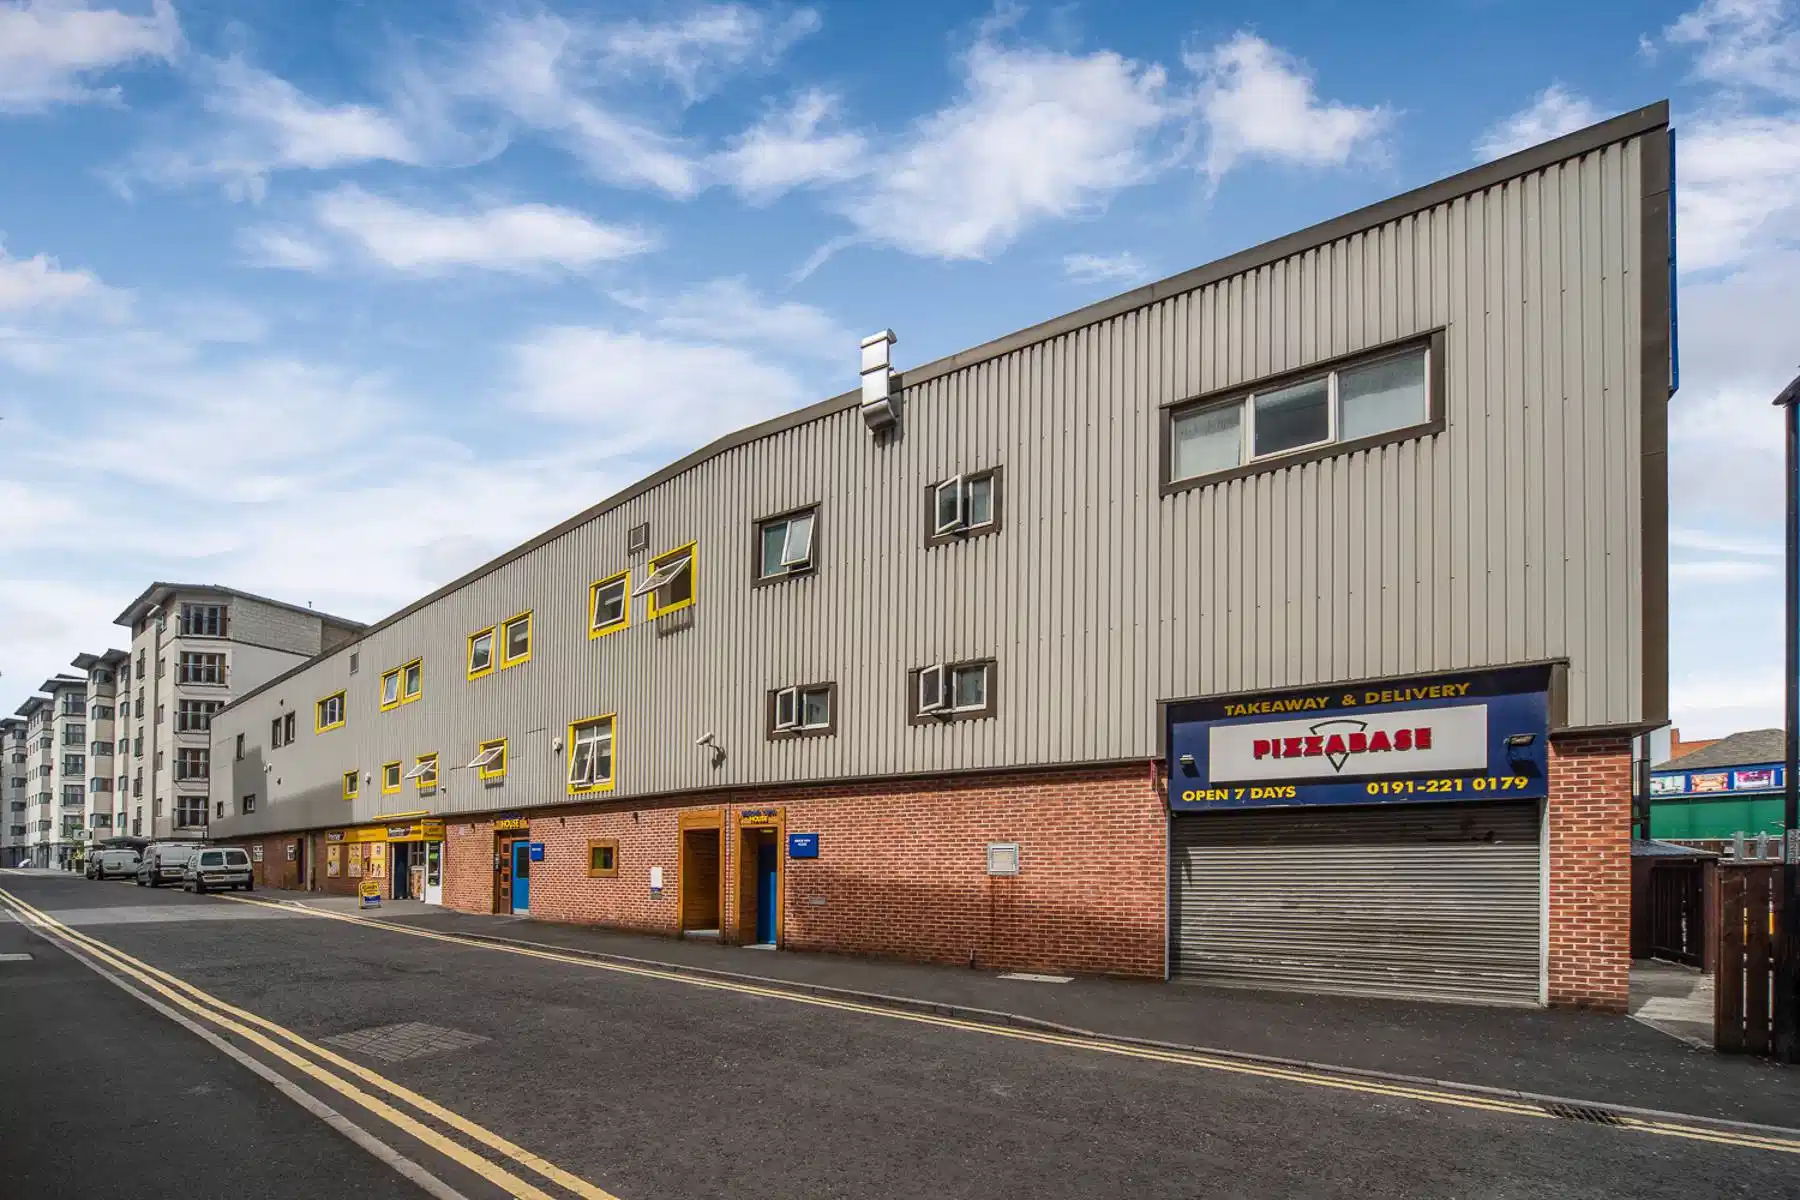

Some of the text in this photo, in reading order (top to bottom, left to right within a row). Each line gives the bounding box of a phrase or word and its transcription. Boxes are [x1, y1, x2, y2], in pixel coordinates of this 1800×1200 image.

[1223, 682, 1472, 716] TAKEAWAY & DELIVERY
[1253, 727, 1432, 760] PIZZABASE
[1182, 786, 1297, 801] OPEN 7 DAYS
[1366, 776, 1529, 795] 0191-221 0179
[502, 819, 520, 828] HOUSE
